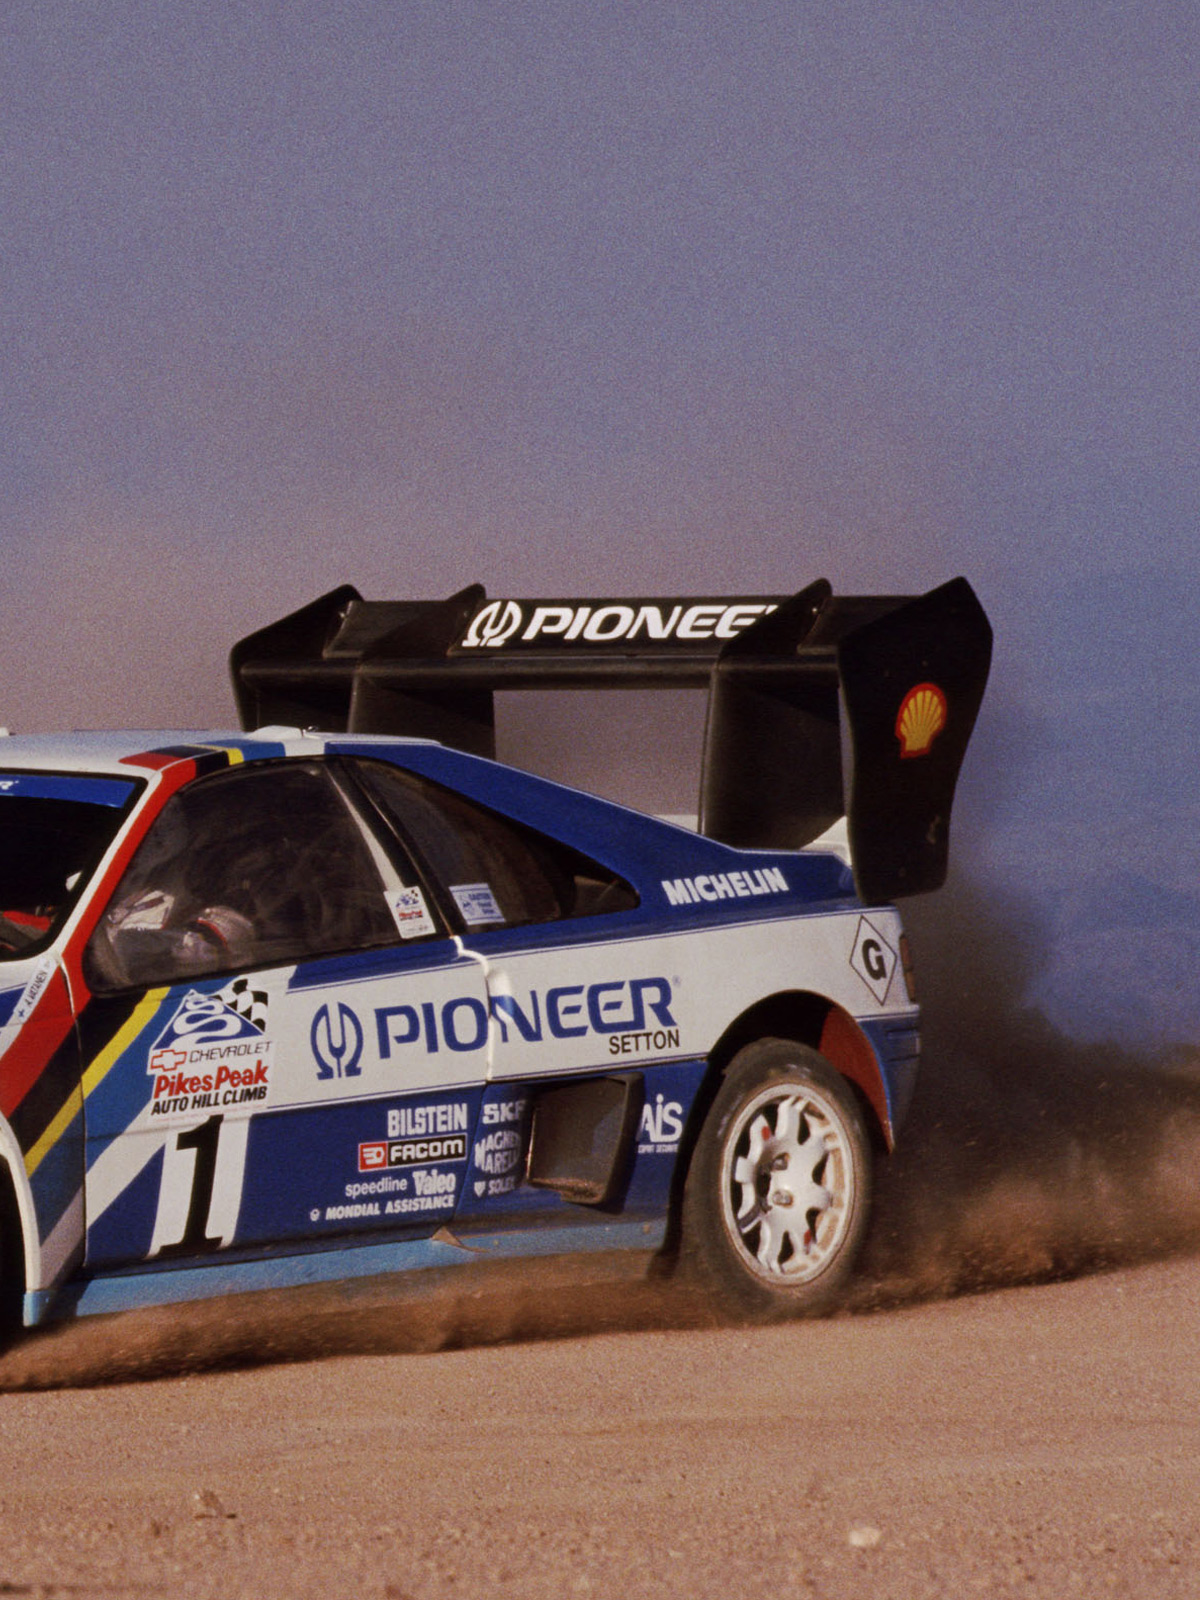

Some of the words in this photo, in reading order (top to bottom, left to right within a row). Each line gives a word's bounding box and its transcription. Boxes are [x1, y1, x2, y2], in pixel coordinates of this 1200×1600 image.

[521, 604, 779, 640] PIONEE
[662, 867, 790, 905] MICHELIN
[861, 938, 887, 981] G
[374, 977, 678, 1060] PIONEER
[189, 1041, 272, 1063] CHEVROLET
[609, 1029, 680, 1055] SETTON
[154, 1072, 213, 1099] Pikes
[214, 1059, 269, 1090] Peak
[151, 1096, 189, 1116] AUTO
[191, 1091, 220, 1109] HILL
[222, 1085, 268, 1105] CLIMB
[482, 1100, 526, 1124] SKF
[387, 1103, 468, 1138] BILSTEIN
[390, 1140, 463, 1162] FACOM
[157, 1114, 224, 1254] 1
[345, 1177, 408, 1200] speedline
[412, 1169, 456, 1196] Valeo
[325, 1203, 381, 1220] MONDIAL
[385, 1195, 455, 1214] ASSISTANCE
